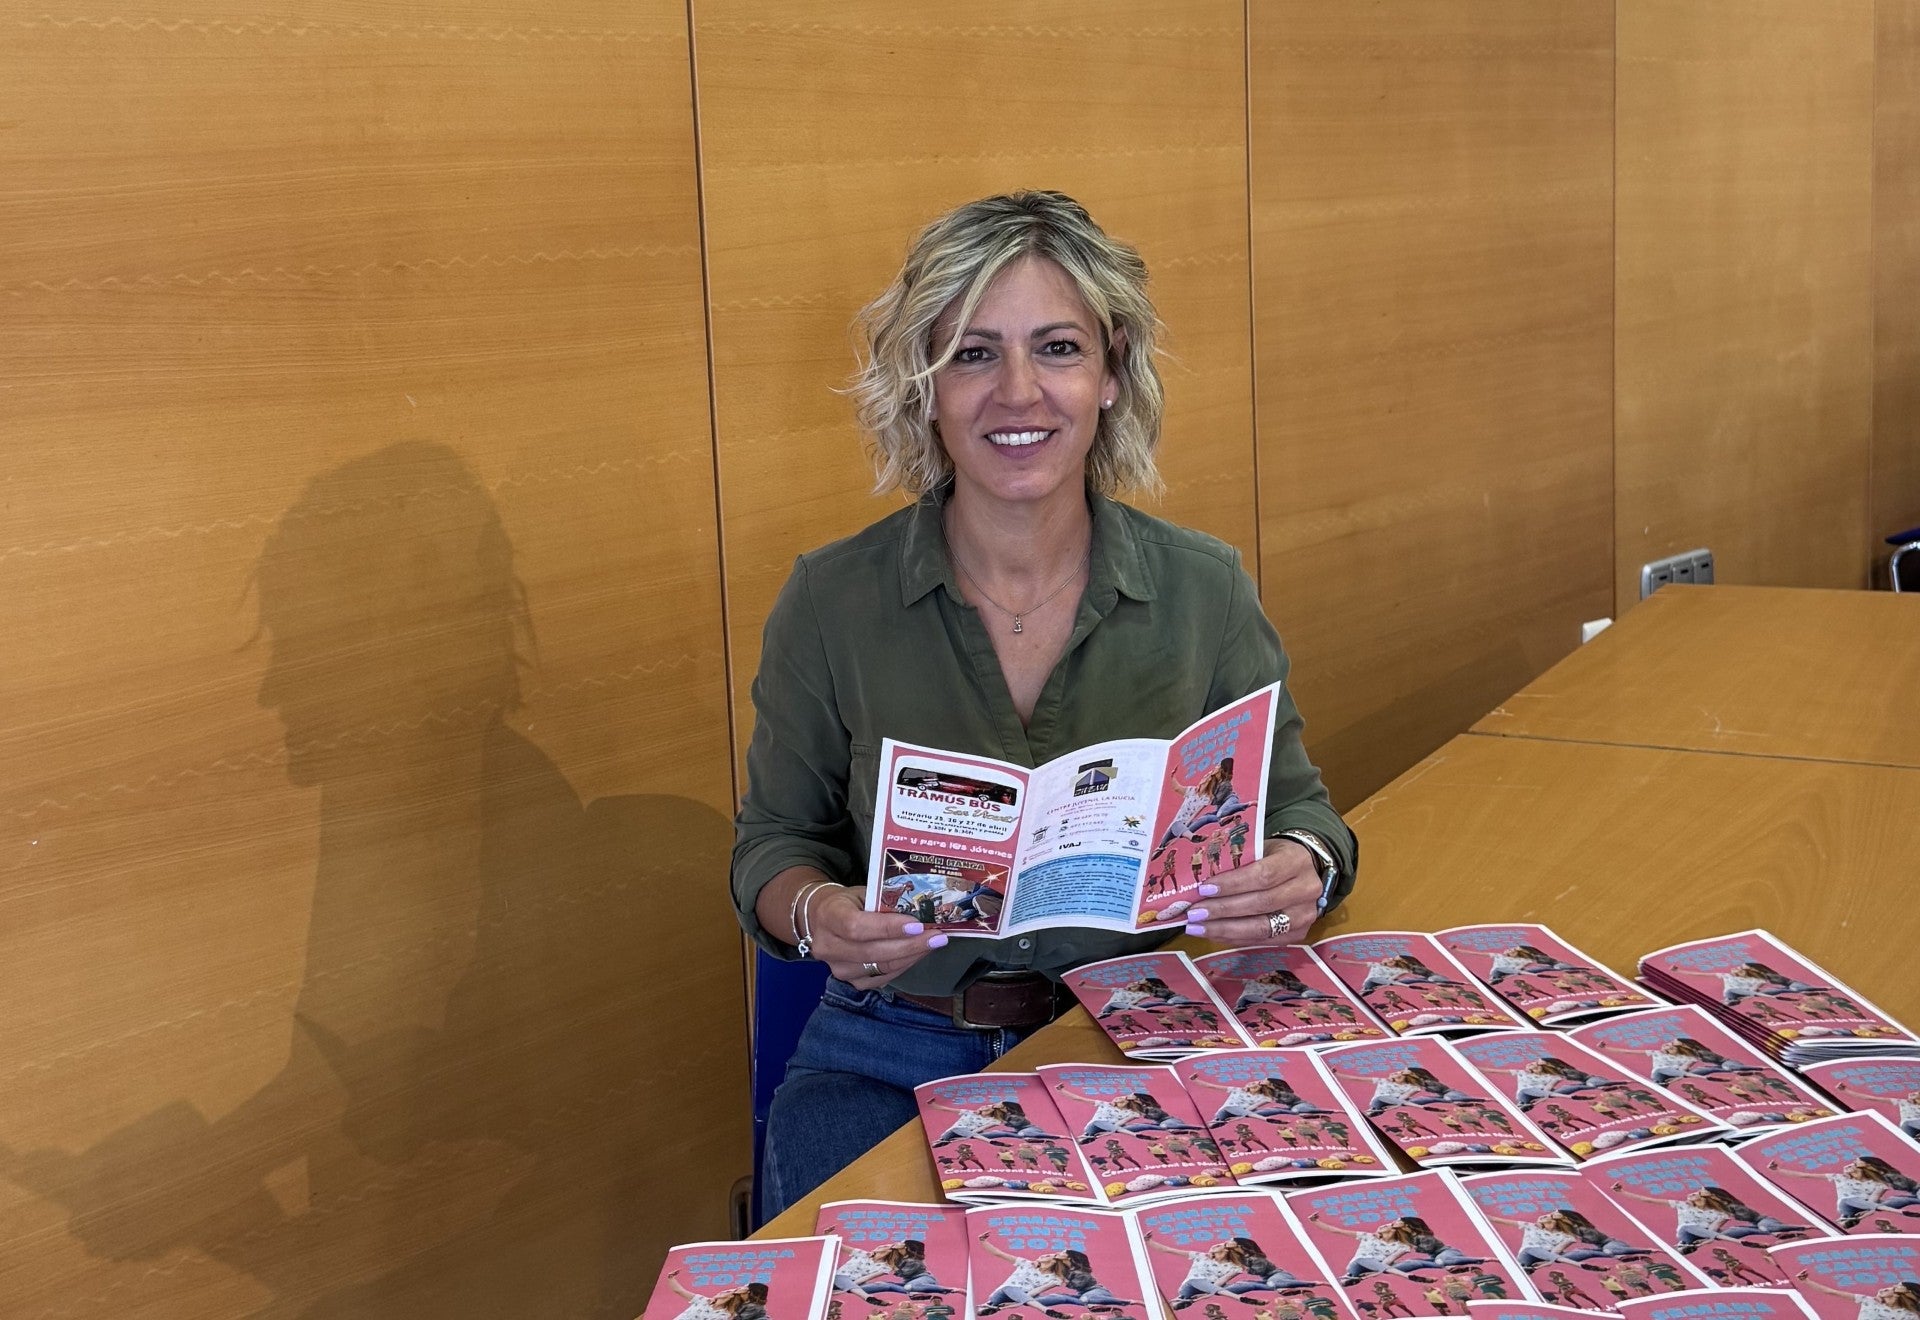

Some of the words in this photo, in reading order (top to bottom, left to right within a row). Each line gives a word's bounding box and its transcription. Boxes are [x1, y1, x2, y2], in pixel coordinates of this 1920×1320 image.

[897, 786, 965, 806] TRAMUS
[969, 799, 1001, 812] BUS
[887, 834, 907, 842] por
[920, 839, 946, 849] para
[1059, 841, 1081, 850] IVAJ
[837, 1211, 945, 1221] SEMANA
[844, 1221, 928, 1230] SANTA
[683, 1249, 795, 1264] SEMANA
[689, 1260, 776, 1274] SANTA
